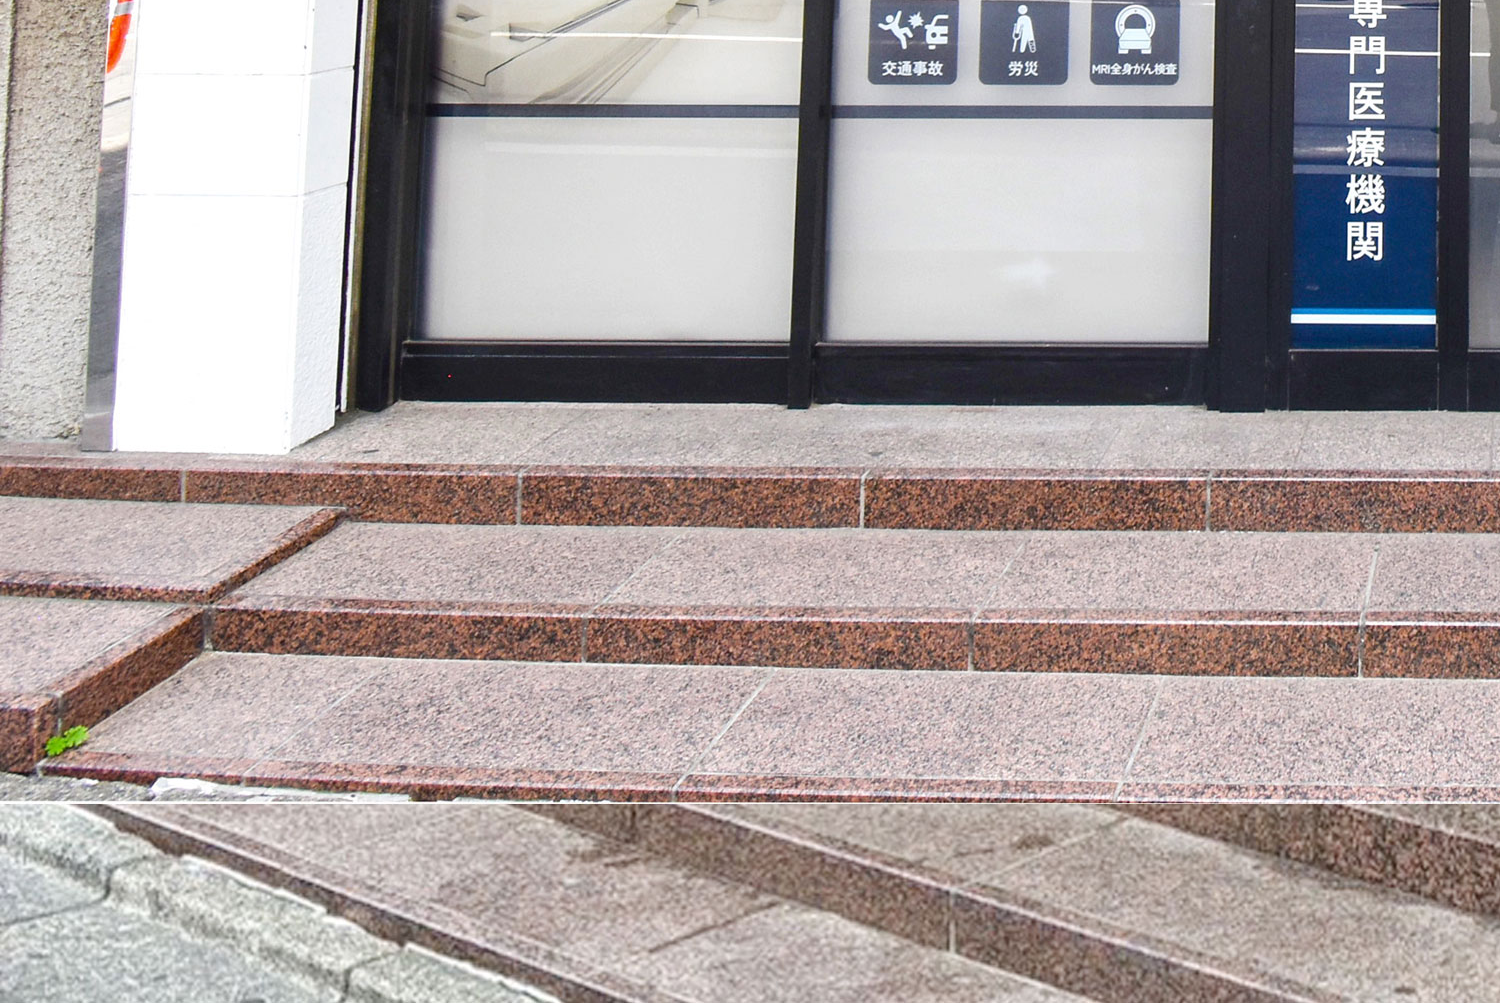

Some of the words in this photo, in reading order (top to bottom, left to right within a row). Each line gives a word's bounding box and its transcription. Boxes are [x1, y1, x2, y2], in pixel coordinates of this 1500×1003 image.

[882, 61, 943, 77] 交通事故
[1008, 61, 1039, 77] 労災
[1092, 63, 1177, 76] MRI全身がん検査
